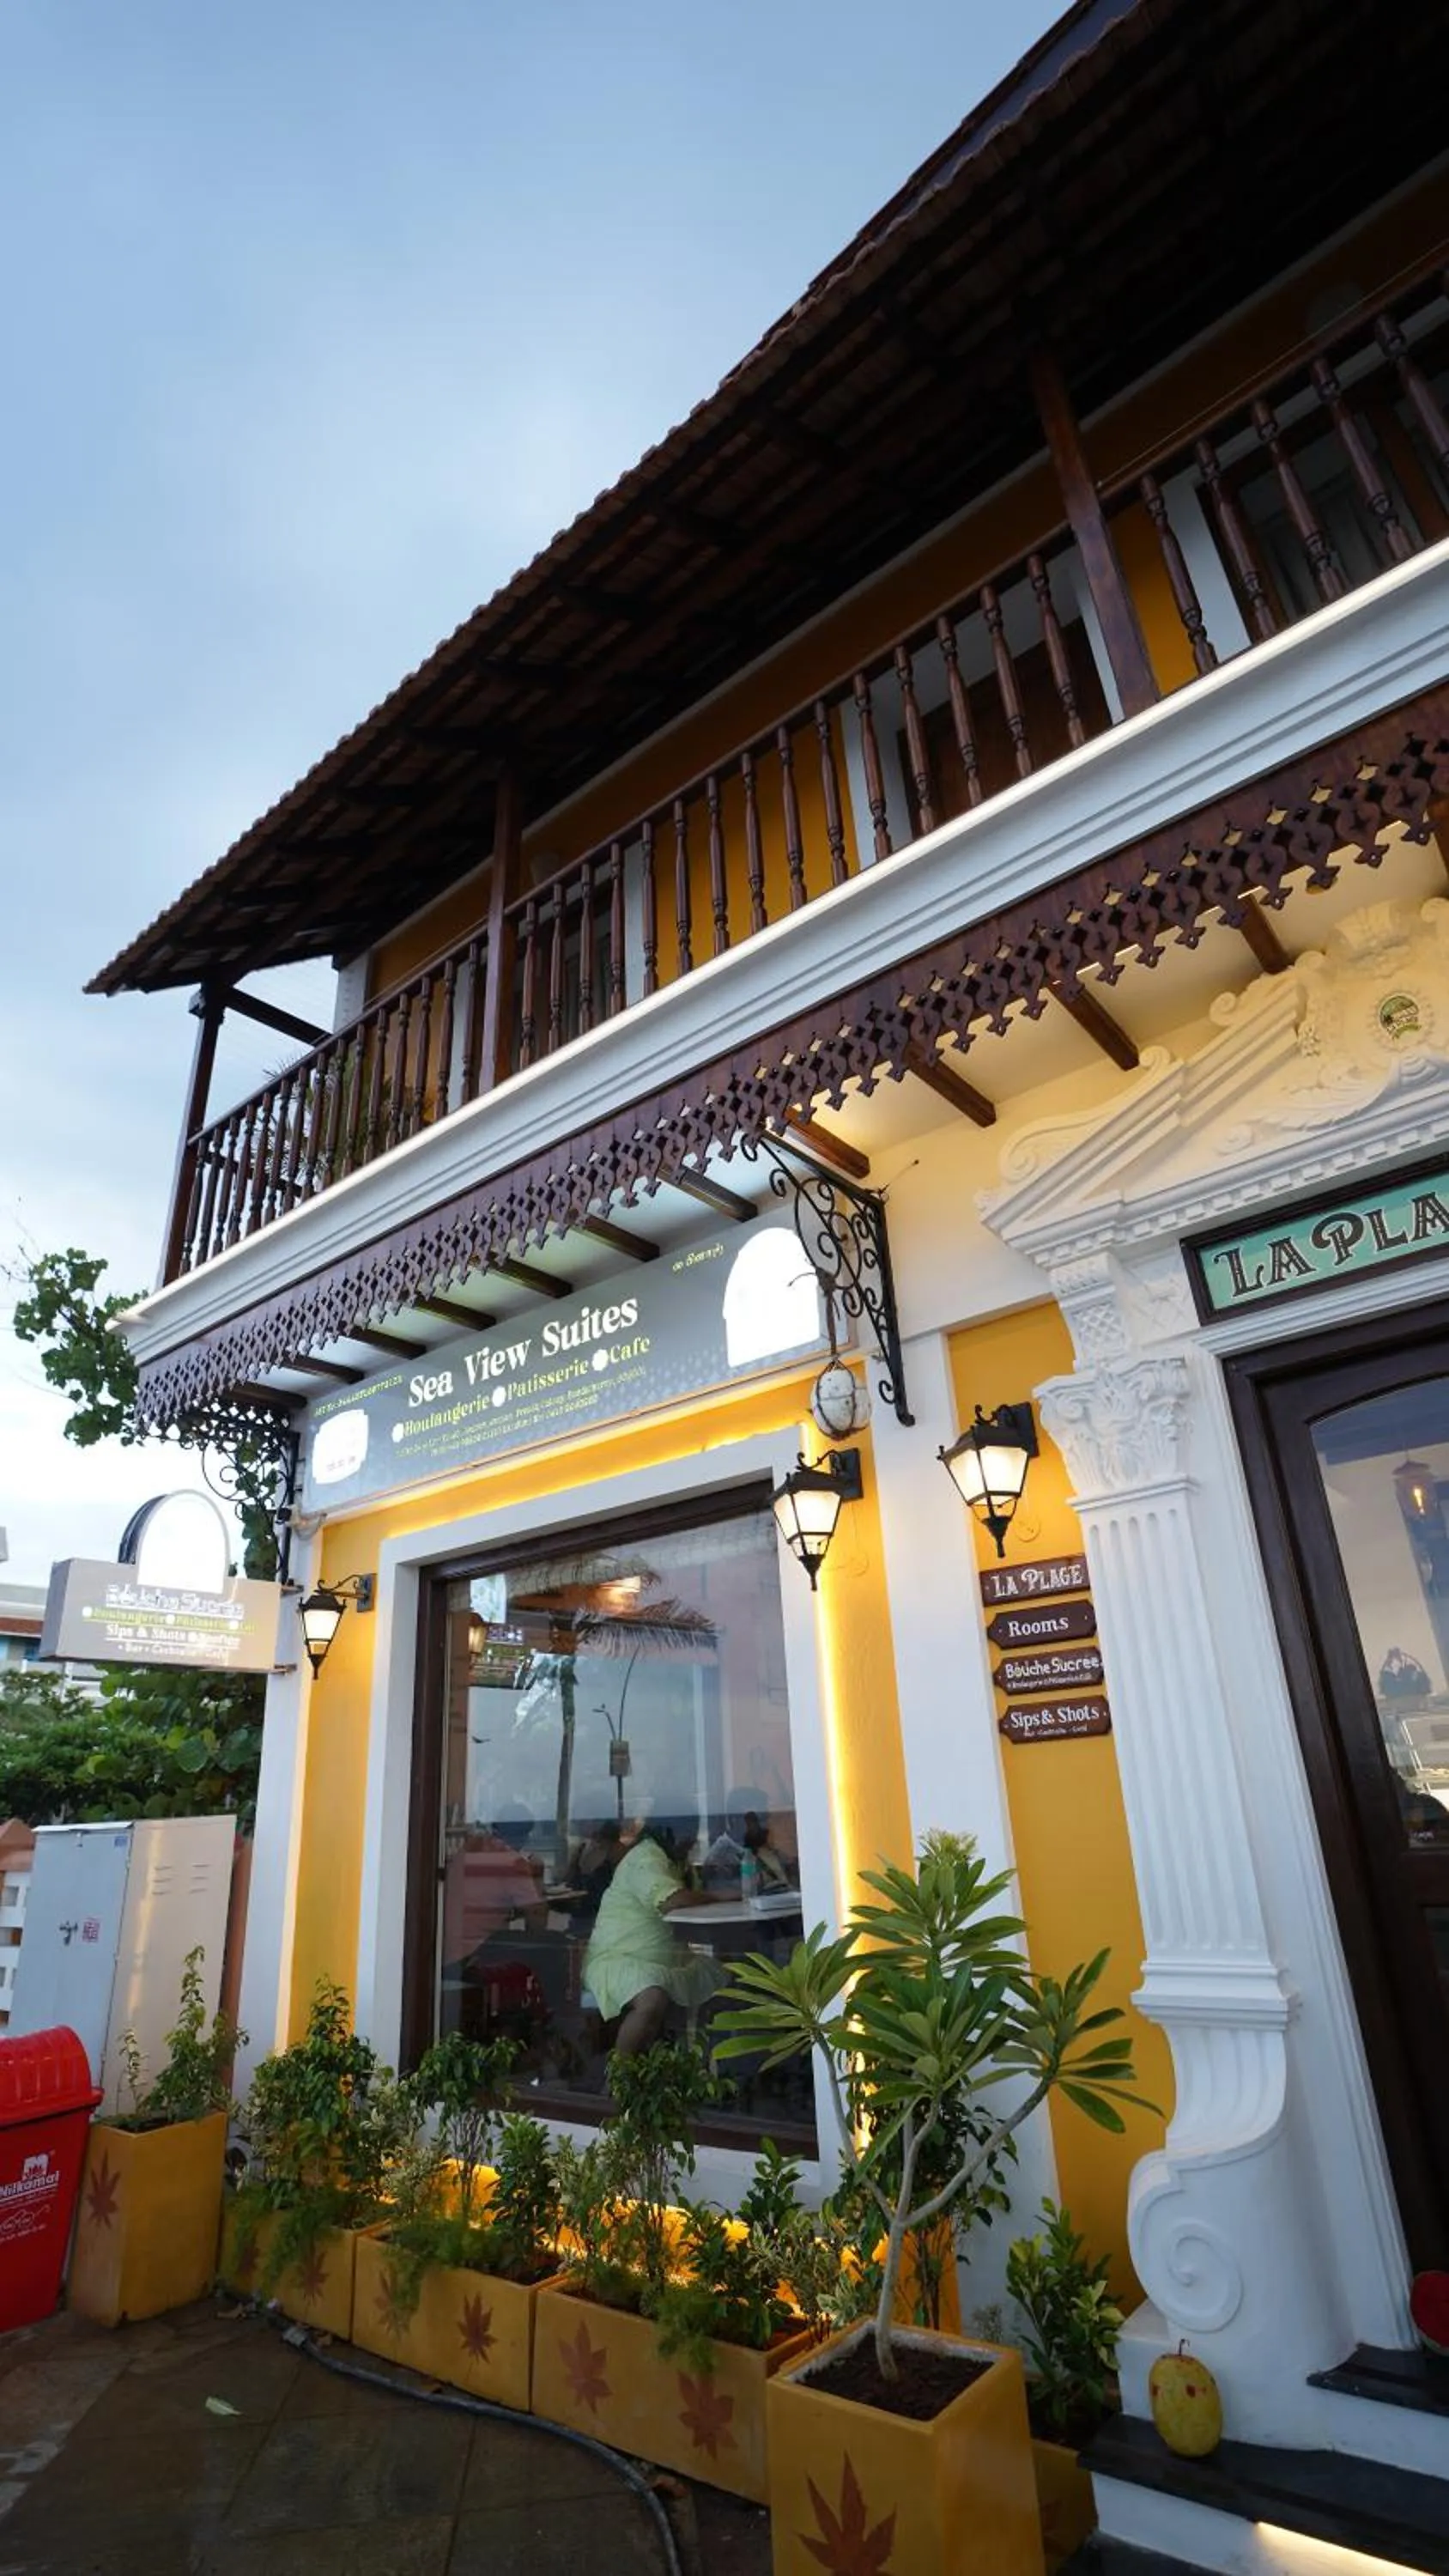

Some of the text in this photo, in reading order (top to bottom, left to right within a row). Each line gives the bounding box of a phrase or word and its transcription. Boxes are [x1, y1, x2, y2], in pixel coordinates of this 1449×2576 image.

[1213, 1236, 1316, 1297] LA
[409, 1371, 453, 1408] Sea
[464, 1339, 531, 1385] View
[542, 1297, 639, 1358] Suites
[991, 1564, 1083, 1597] LA PLAGE
[1008, 1617, 1070, 1638] Rooms
[1057, 1704, 1100, 1723] Shots
